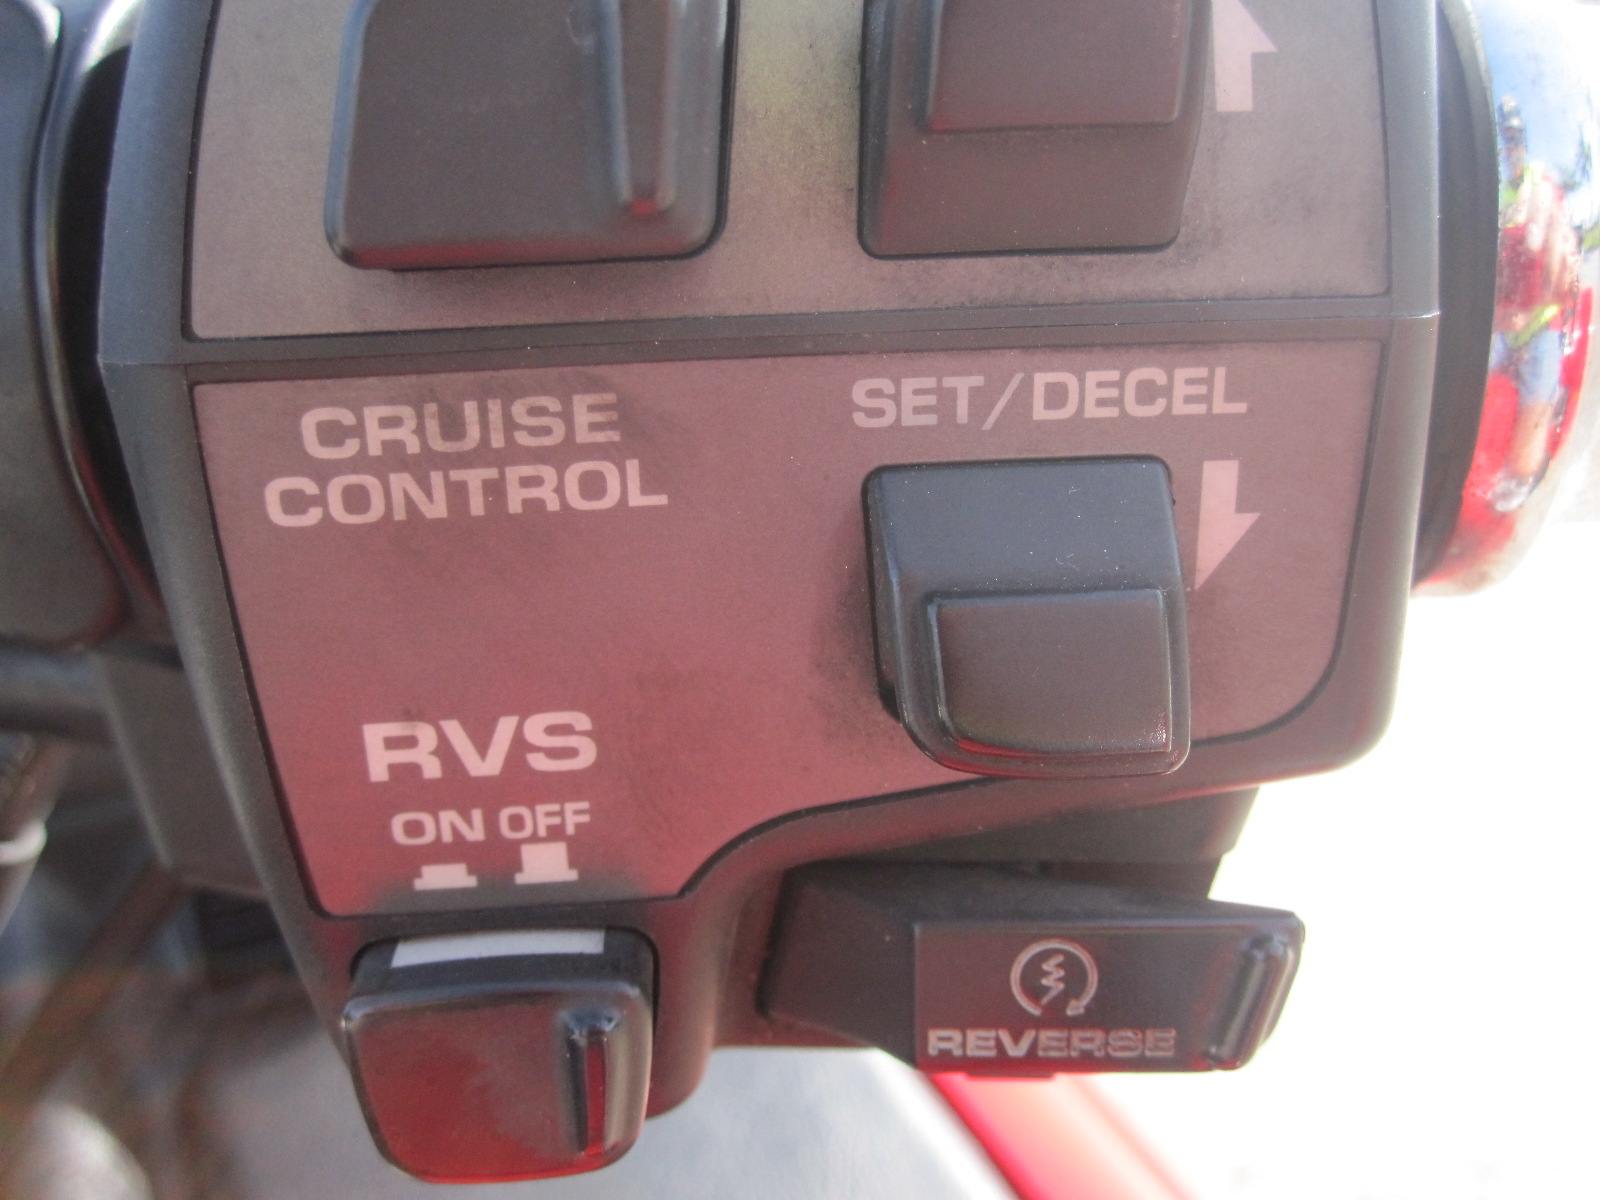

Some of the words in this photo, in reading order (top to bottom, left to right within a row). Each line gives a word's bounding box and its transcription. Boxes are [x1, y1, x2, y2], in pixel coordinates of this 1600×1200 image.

[300, 393, 621, 459] CRUISE
[851, 366, 1248, 430] SET/DECEL
[264, 459, 669, 528] CONTROL
[362, 711, 598, 783] RVS
[391, 808, 486, 846] ON
[498, 801, 591, 840] OFF
[927, 1027, 1177, 1058] REVERSE
